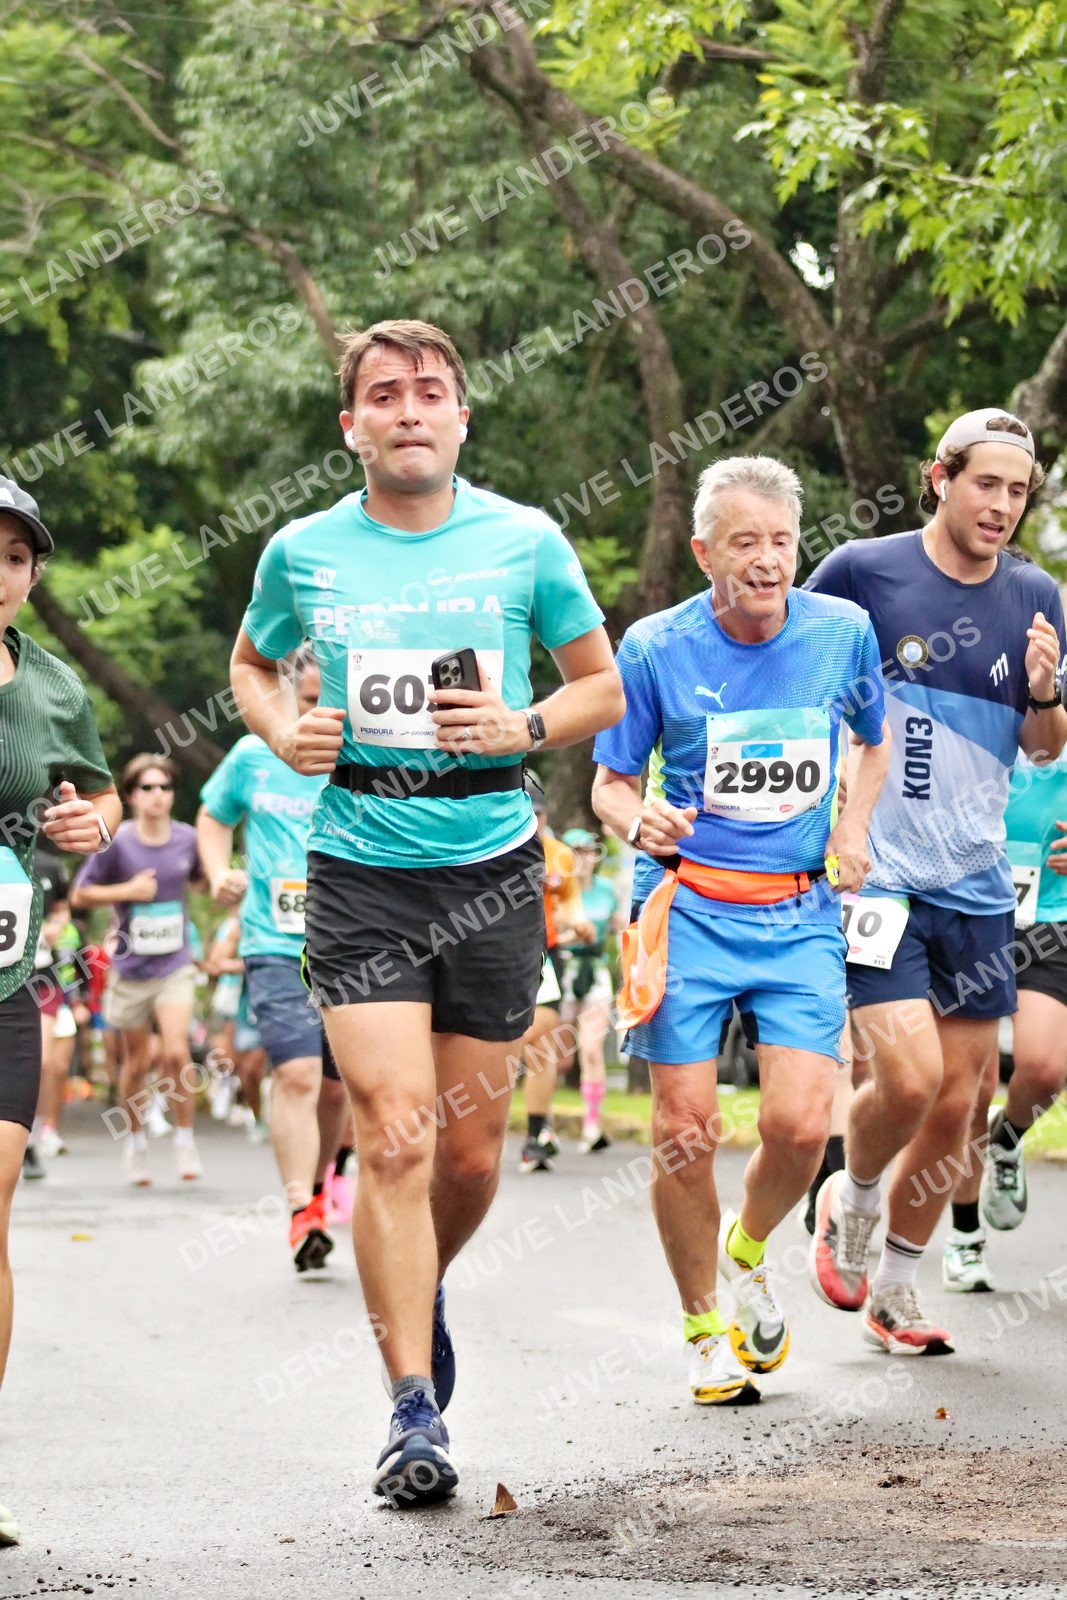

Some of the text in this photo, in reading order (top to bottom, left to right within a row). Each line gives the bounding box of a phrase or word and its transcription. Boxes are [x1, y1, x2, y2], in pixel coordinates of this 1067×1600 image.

[455, 567, 508, 582] BROOKS
[360, 727, 393, 736] PERDURA
[902, 716, 934, 801] KON3
[713, 760, 820, 794] 2990
